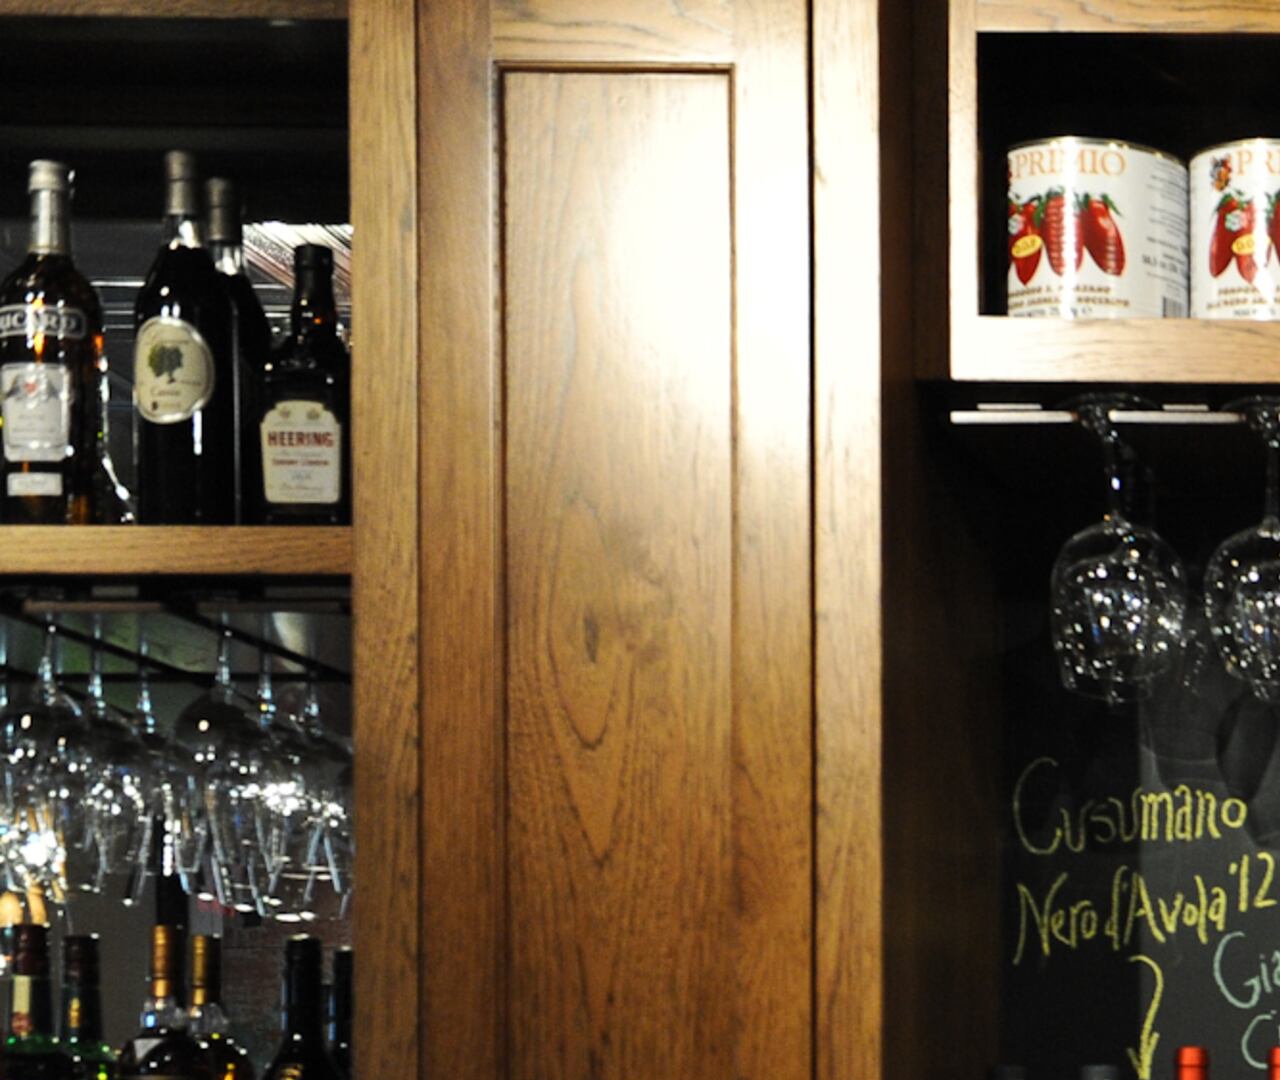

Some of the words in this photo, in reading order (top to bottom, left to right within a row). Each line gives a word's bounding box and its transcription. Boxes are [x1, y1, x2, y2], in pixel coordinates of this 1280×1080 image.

[267, 431, 335, 448] HEERING
[1013, 757, 1248, 855] Cusumano
[1012, 871, 1098, 966] Nero
